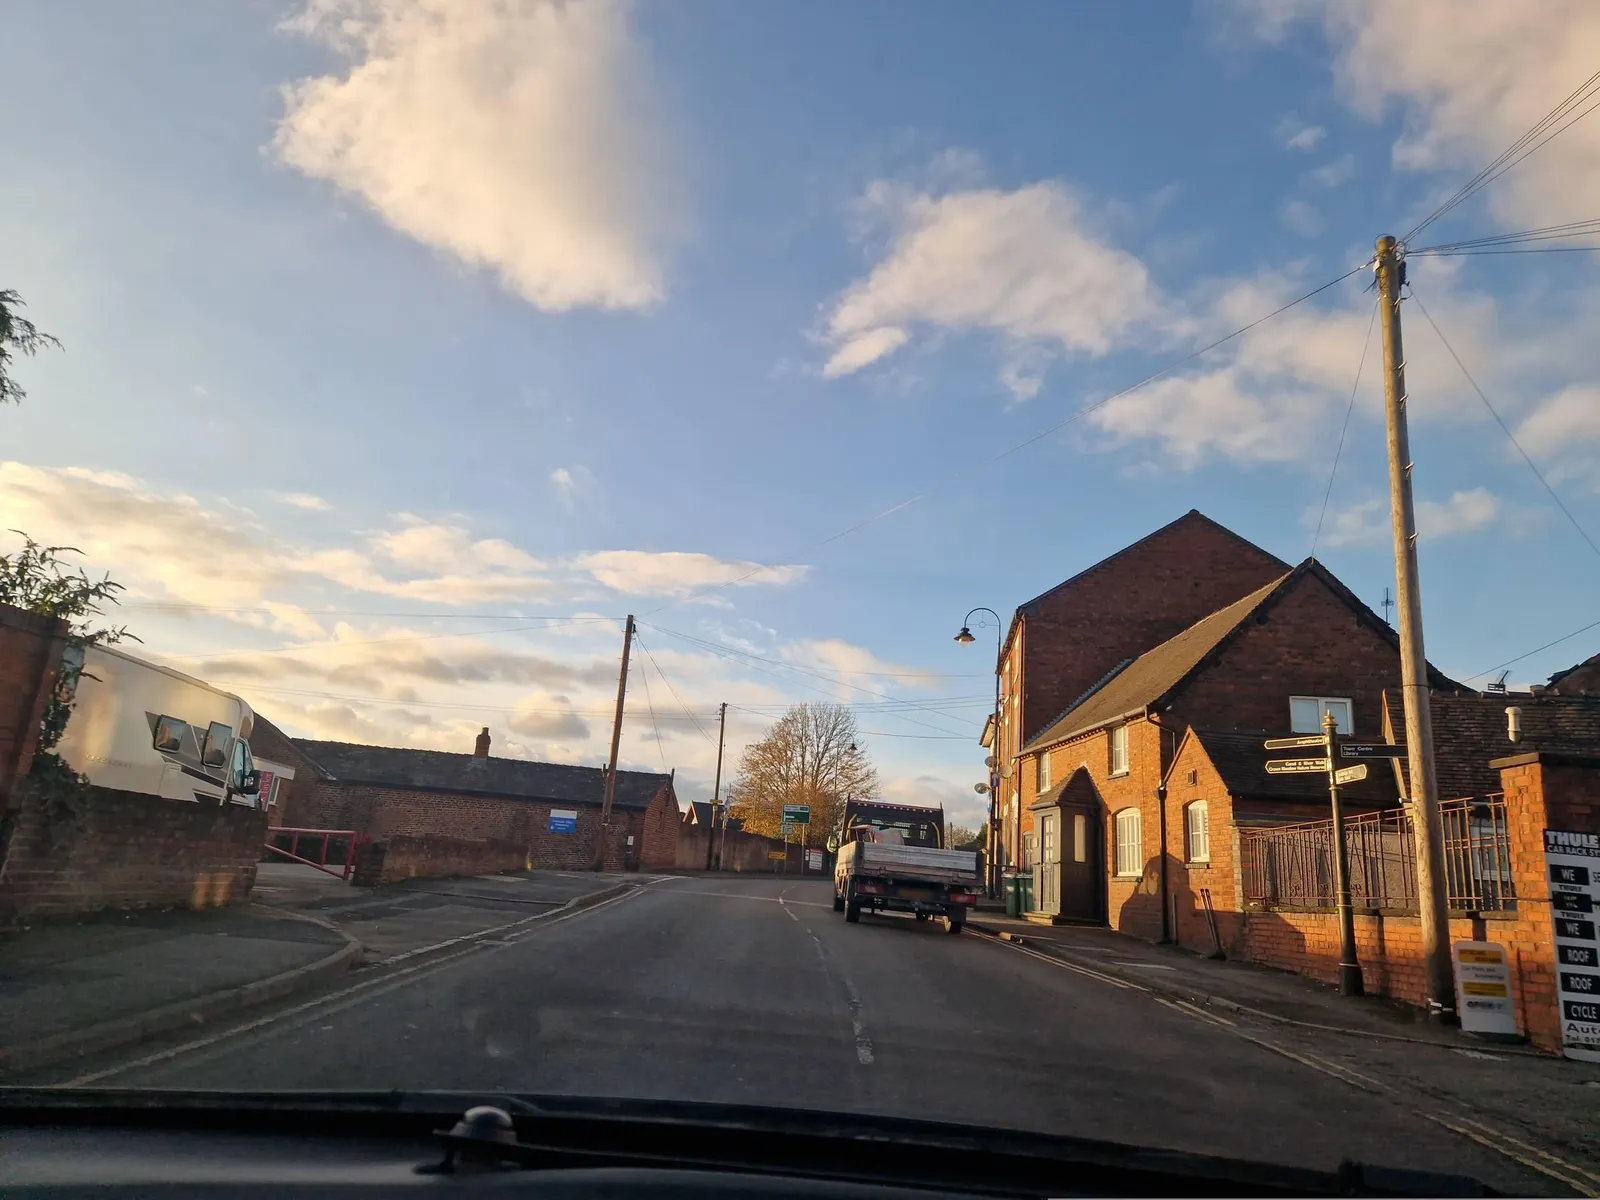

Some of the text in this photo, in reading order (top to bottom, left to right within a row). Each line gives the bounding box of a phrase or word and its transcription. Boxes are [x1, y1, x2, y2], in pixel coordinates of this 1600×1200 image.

[1546, 831, 1599, 848] THULE
[1547, 844, 1565, 854] CAR
[1565, 846, 1588, 856] RACK
[1561, 868, 1576, 881] WE
[1566, 921, 1580, 936] WE
[1567, 948, 1590, 963] ROOF
[1570, 976, 1592, 990] ROOF
[1571, 1004, 1597, 1020] CYCLE
[1567, 1022, 1600, 1035] Aut
